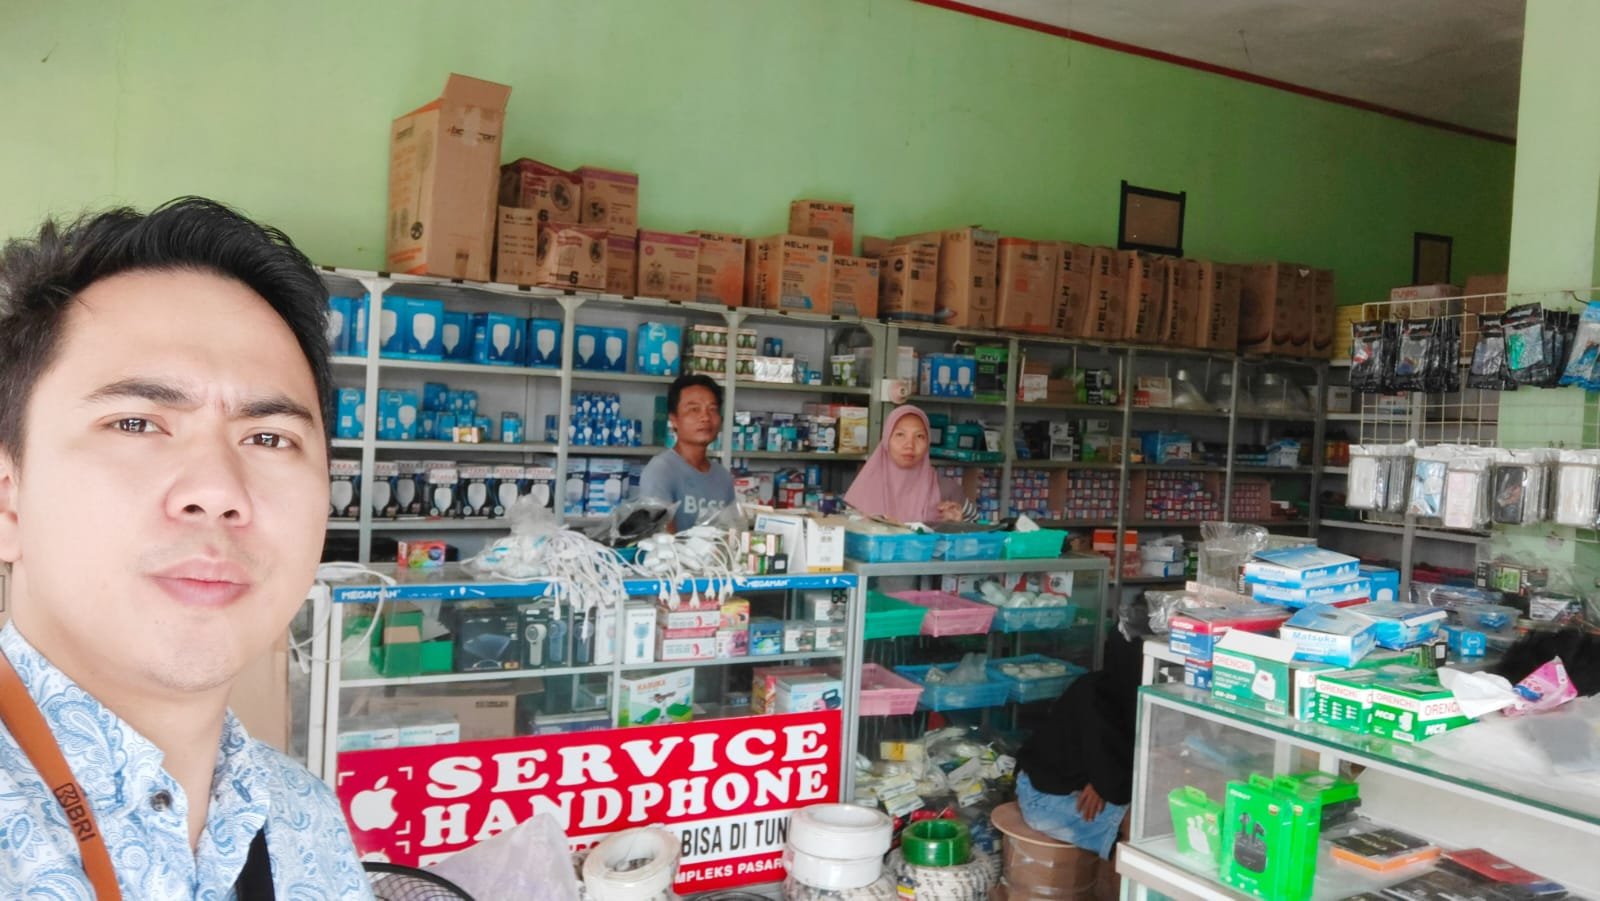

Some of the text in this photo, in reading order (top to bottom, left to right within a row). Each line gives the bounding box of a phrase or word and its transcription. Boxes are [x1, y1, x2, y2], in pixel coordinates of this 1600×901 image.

[426, 722, 828, 799] SERVICE
[420, 763, 829, 848] HANDPHONE
[681, 816, 791, 858] BISA DI TUN
